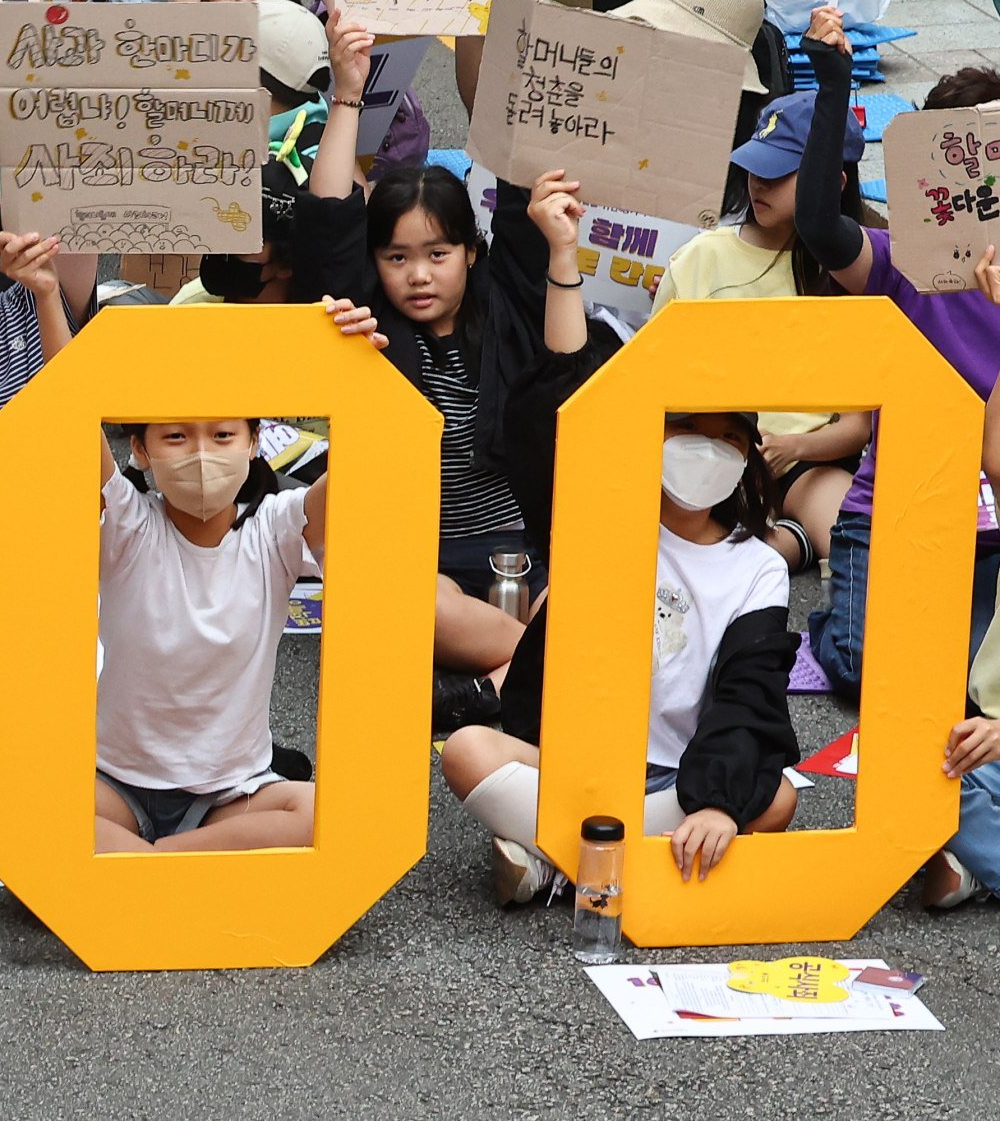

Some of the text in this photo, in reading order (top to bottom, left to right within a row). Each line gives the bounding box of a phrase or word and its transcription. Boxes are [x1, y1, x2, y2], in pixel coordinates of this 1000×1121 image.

[7, 16, 256, 70] 사과 한마디가
[516, 17, 619, 81] 할머니들의
[522, 65, 585, 108] 청춘을
[505, 92, 616, 146] 돌려놓아라
[14, 134, 257, 191] 사죄하라!
[925, 185, 1000, 237] 꽃다운
[589, 218, 659, 259] 함께
[610, 262, 667, 291] 간다
[787, 962, 821, 999] 공식사죄
